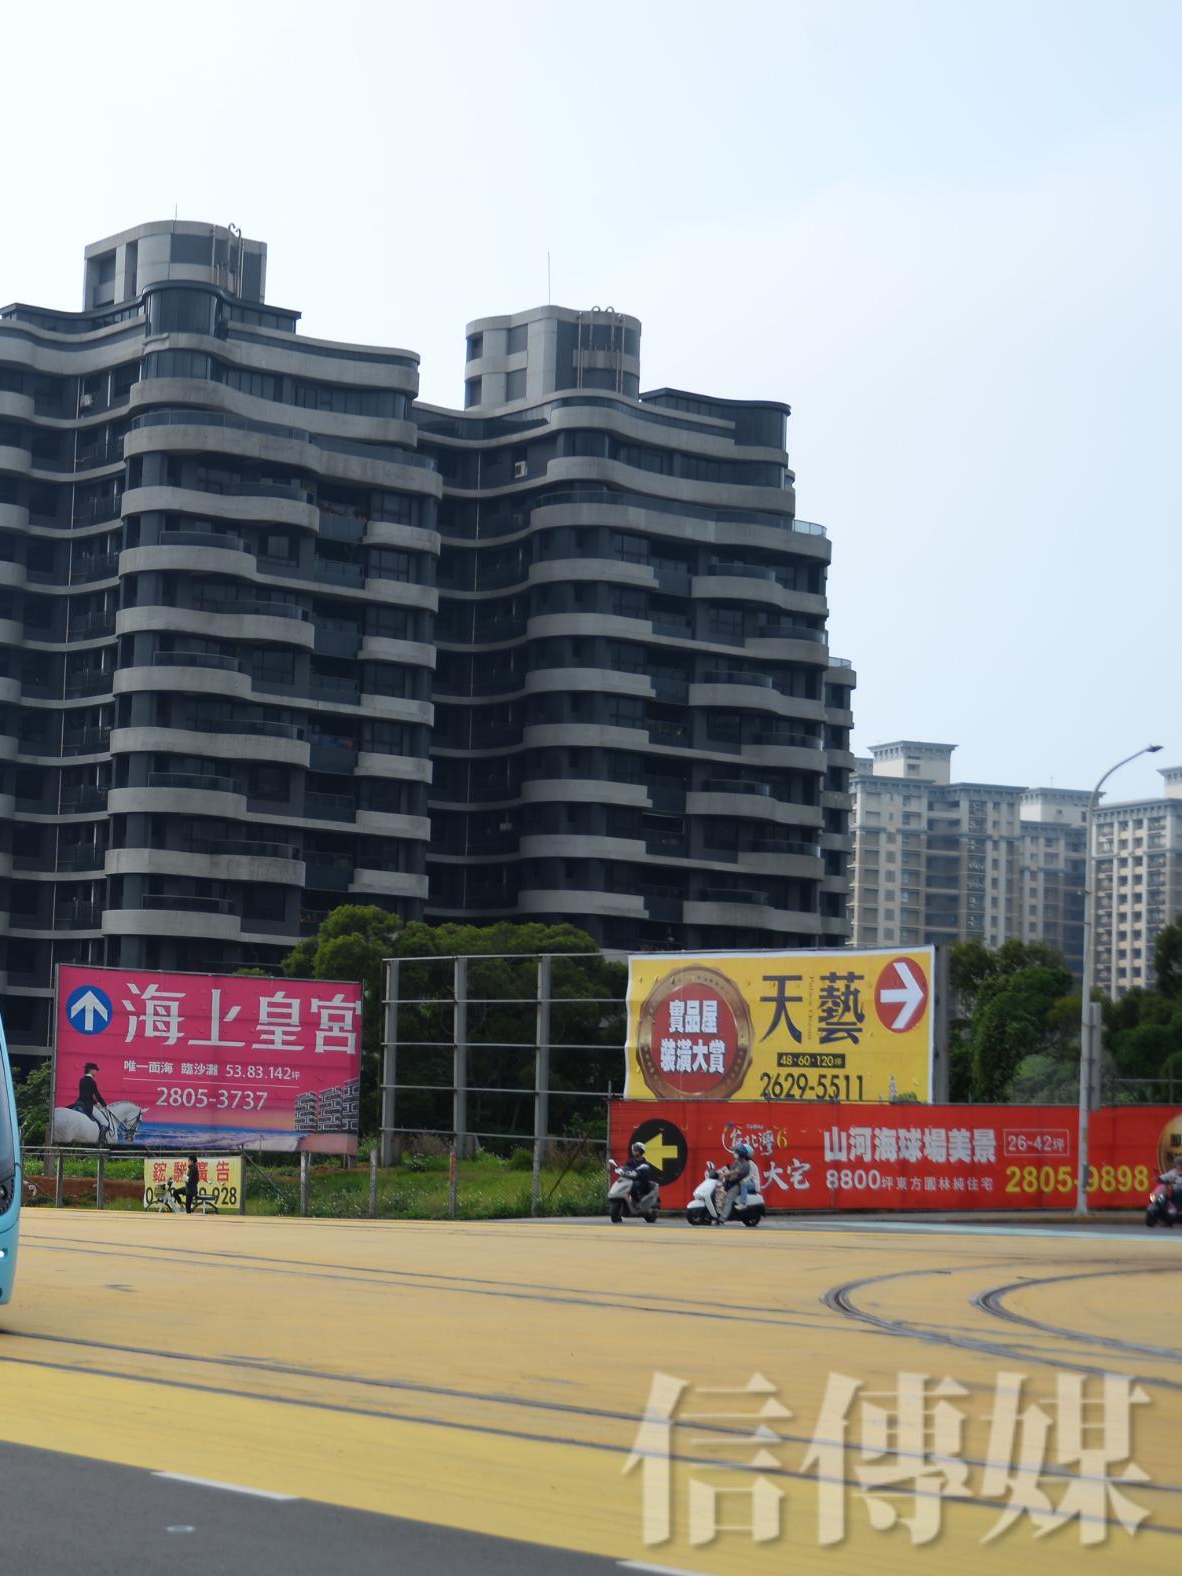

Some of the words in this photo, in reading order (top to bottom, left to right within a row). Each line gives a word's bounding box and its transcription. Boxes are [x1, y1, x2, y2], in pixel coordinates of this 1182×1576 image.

[122, 982, 361, 1054] 海上皇宮
[668, 999, 718, 1033] 實品屋
[123, 1060, 174, 1074] 唯一面海
[156, 1087, 268, 1111] 2805-3737
[759, 1072, 864, 1101] 2629-5511
[823, 1126, 997, 1164] 山河海球場美景
